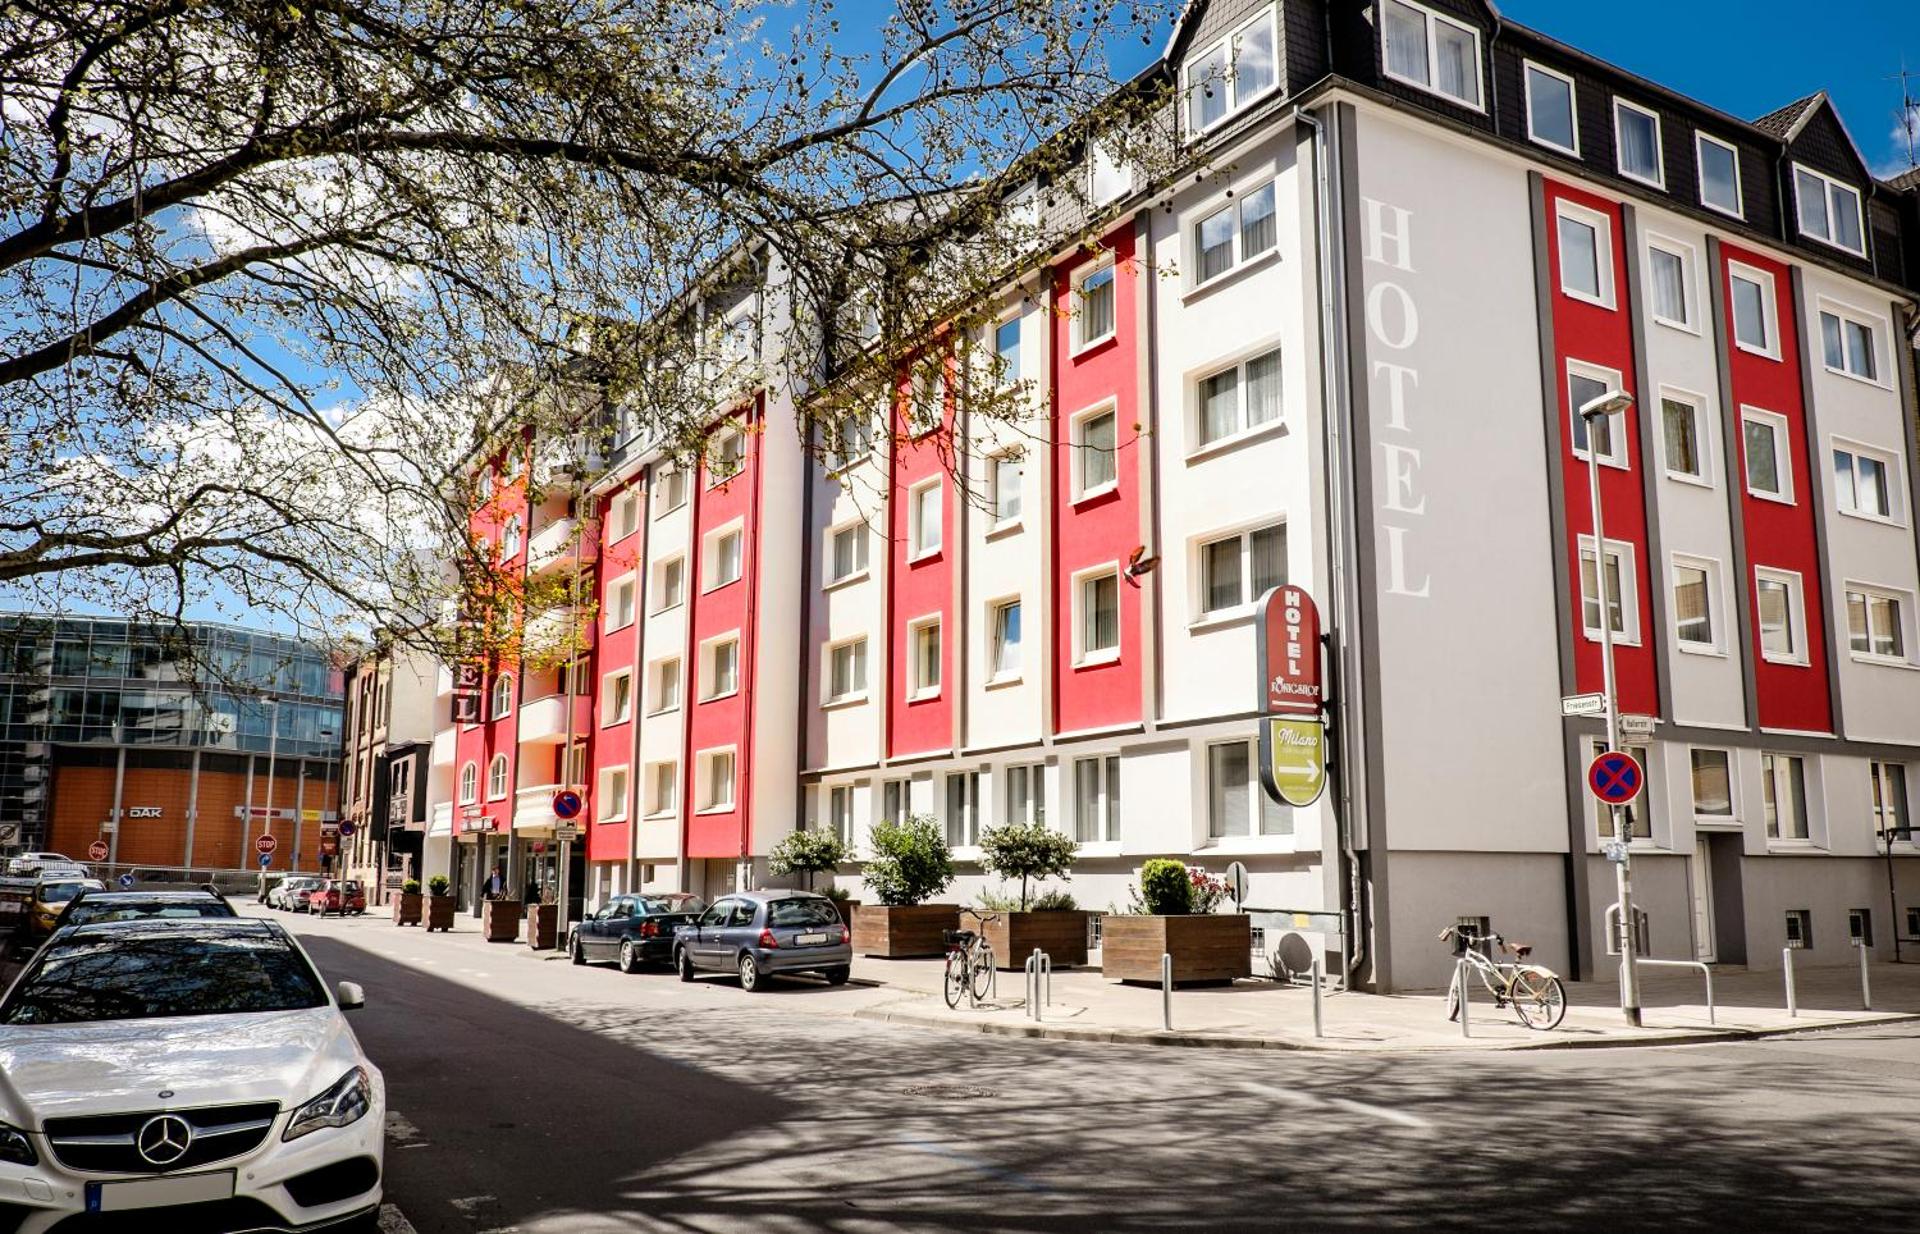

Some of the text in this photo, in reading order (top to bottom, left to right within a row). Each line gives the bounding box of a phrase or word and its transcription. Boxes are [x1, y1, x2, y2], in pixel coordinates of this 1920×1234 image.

[1361, 196, 1430, 598] HOTEL
[1284, 591, 1302, 676] HOTEL
[1278, 728, 1318, 746] Milano
[129, 807, 162, 818] DAK
[258, 840, 275, 849] STOP
